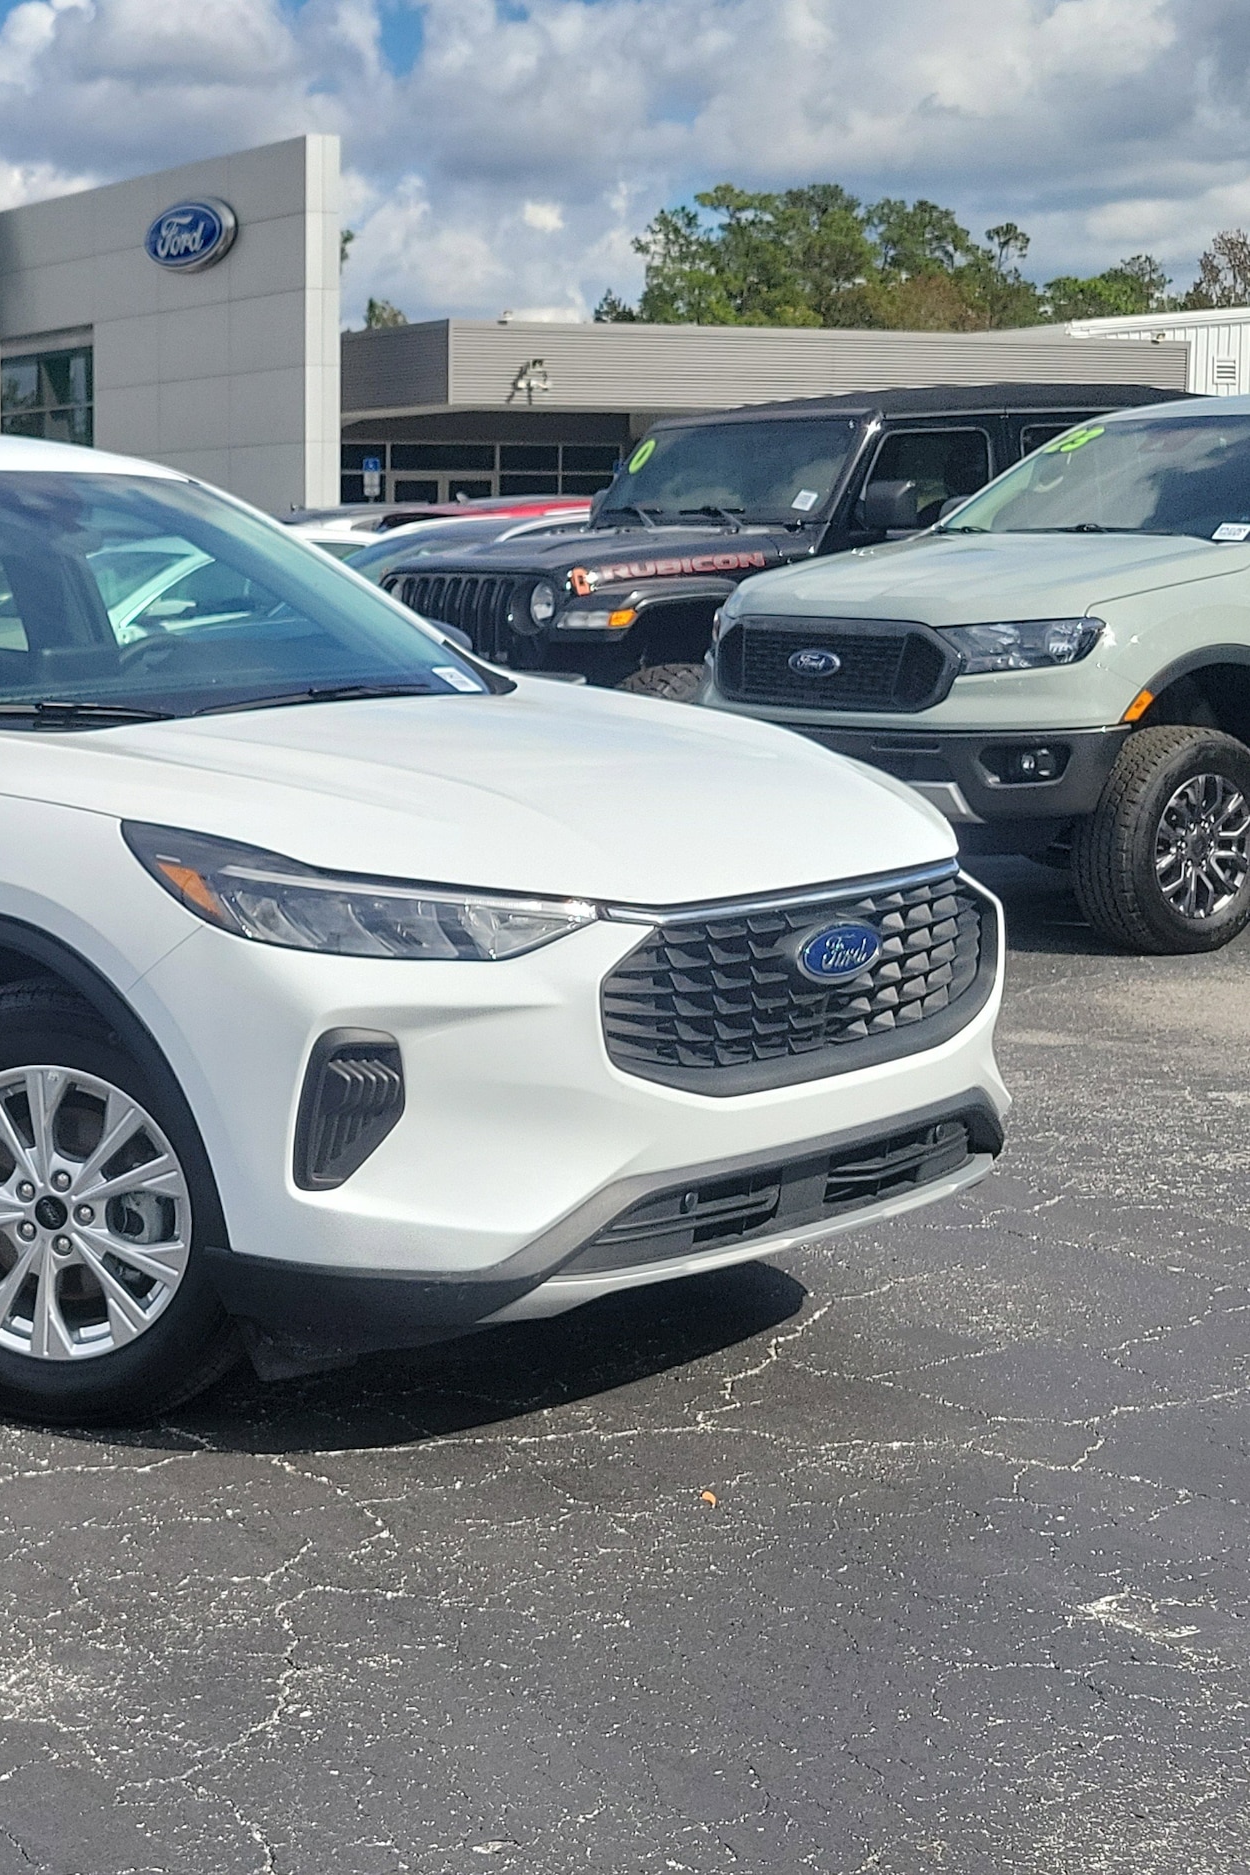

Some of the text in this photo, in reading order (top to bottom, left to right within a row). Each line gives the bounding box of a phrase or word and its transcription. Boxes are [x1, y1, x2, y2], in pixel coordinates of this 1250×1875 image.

[156, 214, 206, 258] Ford
[600, 551, 766, 580] RUBICON
[796, 654, 826, 671] Ford
[821, 933, 867, 970] Ford
